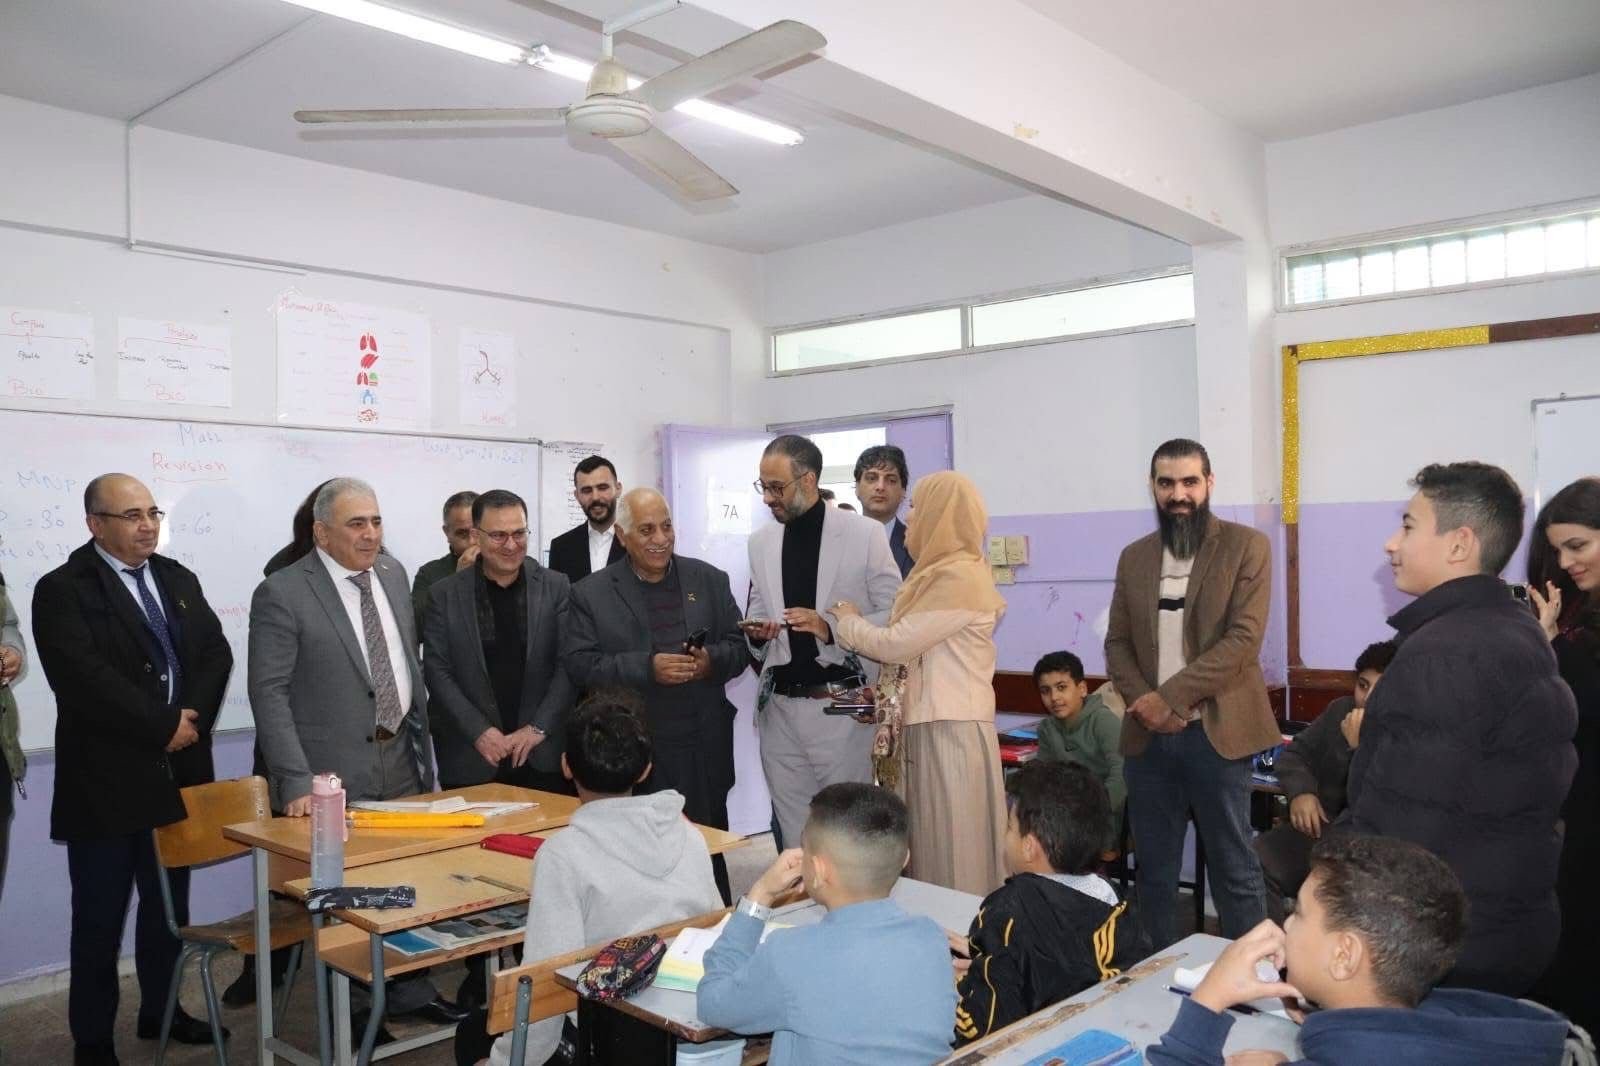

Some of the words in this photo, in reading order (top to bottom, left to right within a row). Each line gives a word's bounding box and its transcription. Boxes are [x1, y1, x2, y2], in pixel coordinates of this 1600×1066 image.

[177, 423, 224, 446] Math
[152, 452, 227, 473] Revision
[722, 504, 739, 521] 7A
